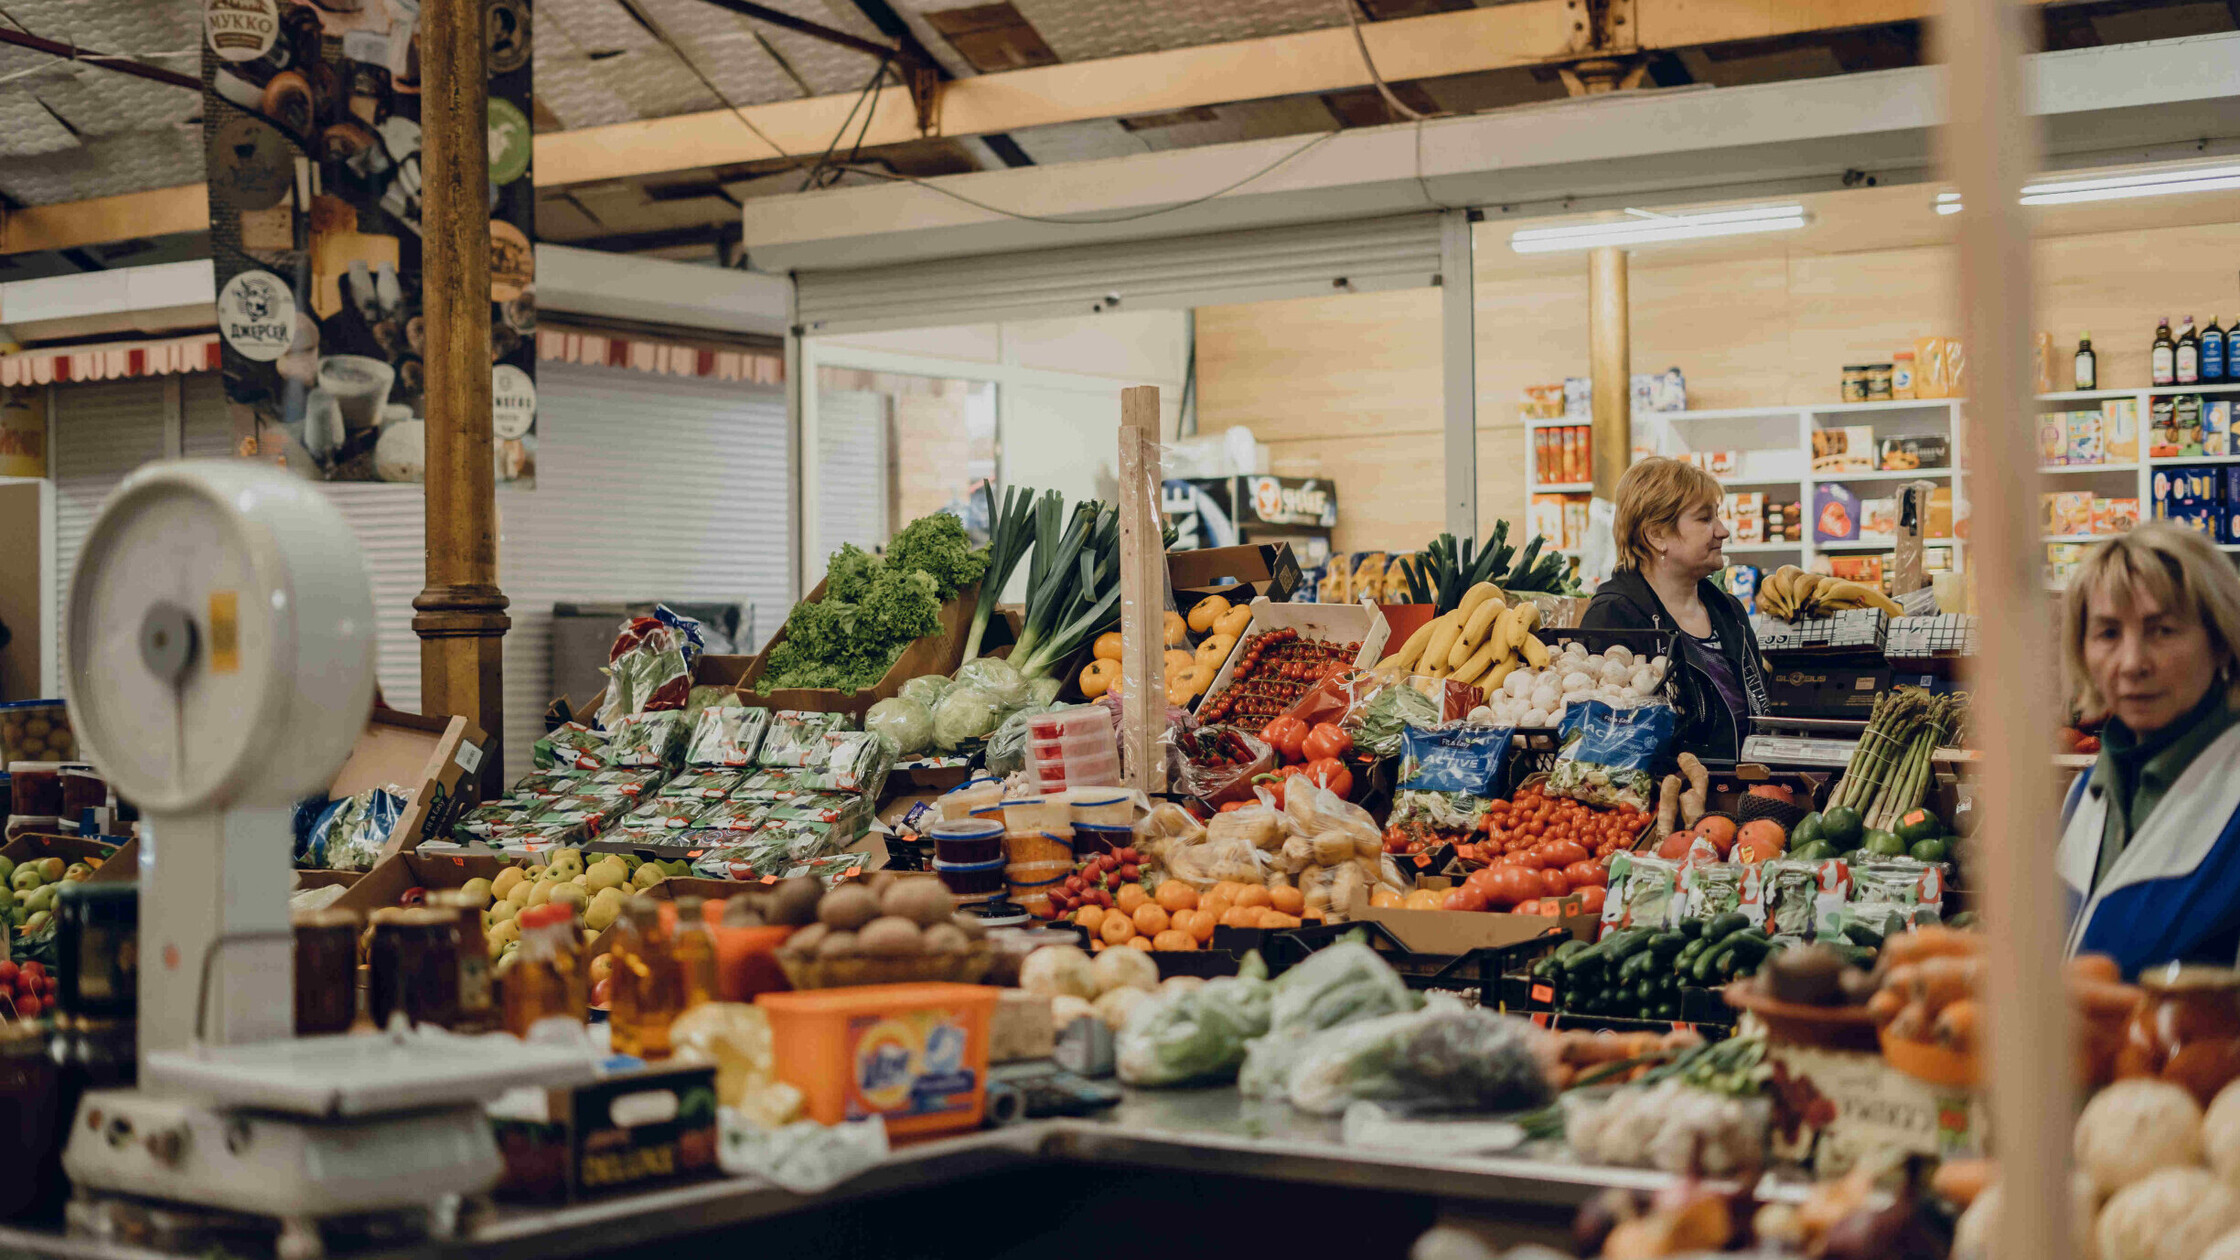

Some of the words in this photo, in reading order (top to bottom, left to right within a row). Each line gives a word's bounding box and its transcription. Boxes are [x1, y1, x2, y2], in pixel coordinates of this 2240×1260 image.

[209, 13, 273, 33] МУККО
[231, 322, 289, 342] ДЖЕРСЕЙ
[1424, 754, 1479, 769] ACTIVE
